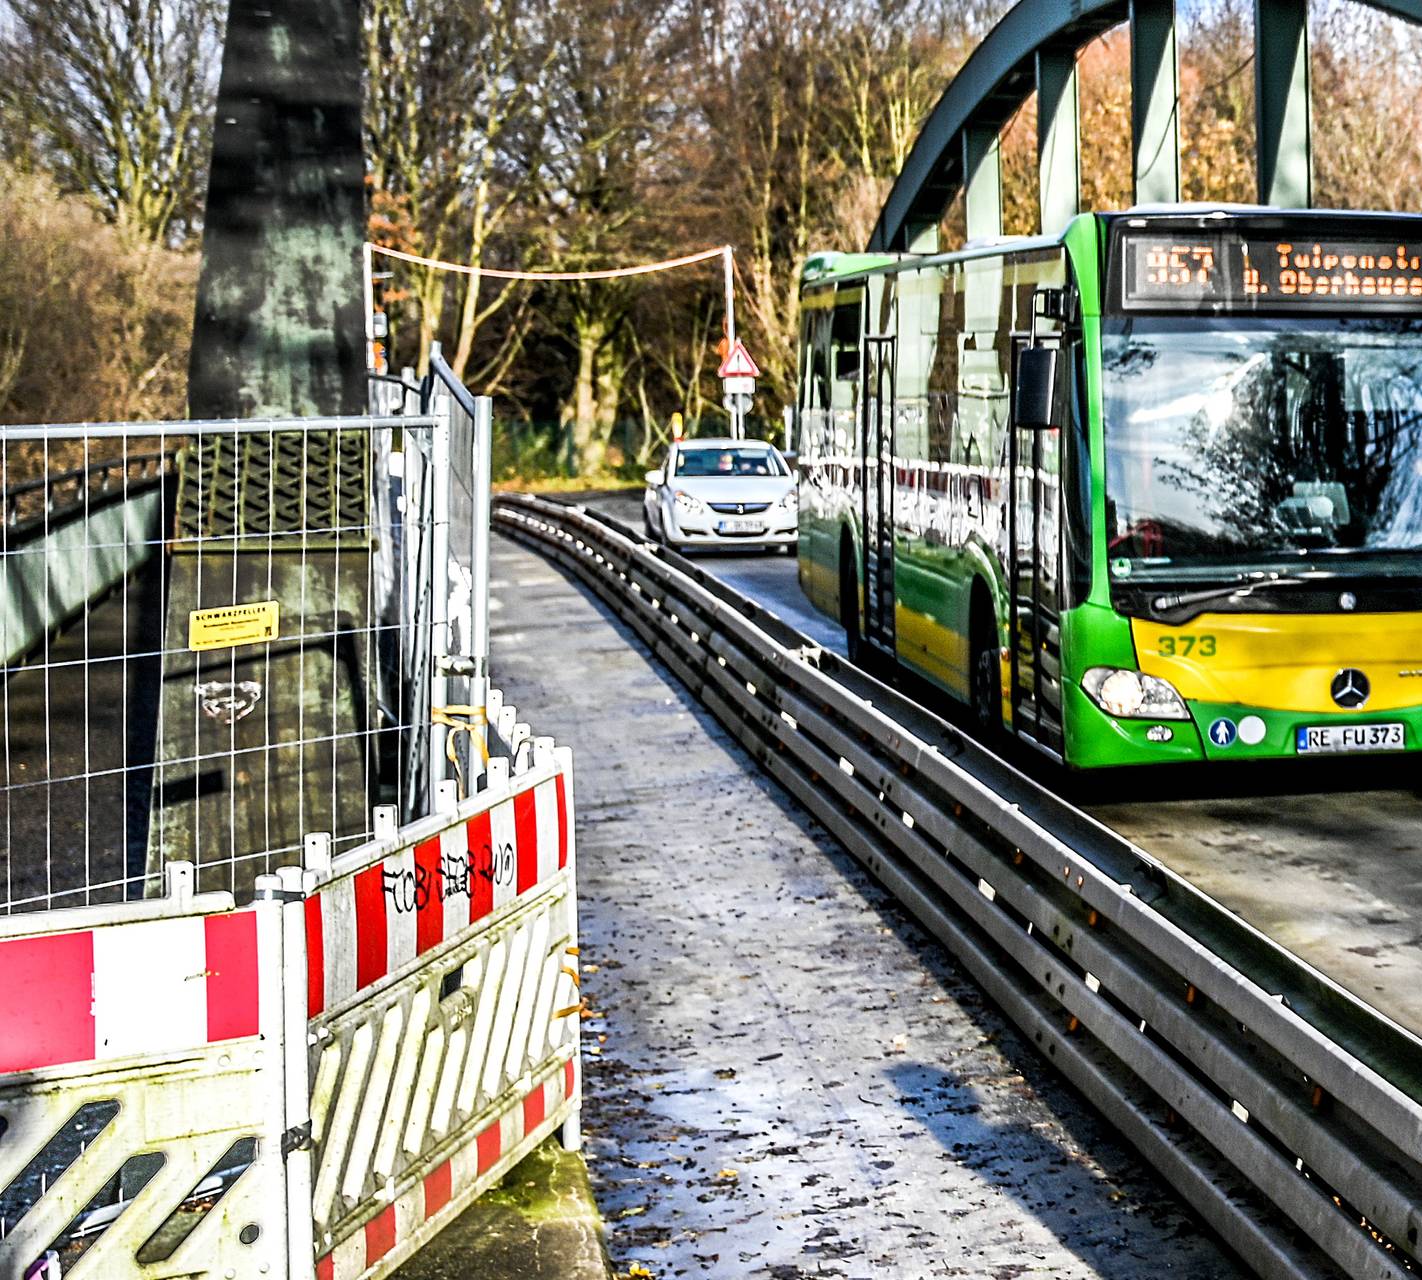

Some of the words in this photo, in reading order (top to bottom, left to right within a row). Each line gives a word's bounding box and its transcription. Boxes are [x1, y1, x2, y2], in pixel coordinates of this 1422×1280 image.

[1158, 635, 1217, 657] 373
[1309, 730, 1331, 746] RE
[1343, 728, 1366, 745] FU
[1370, 727, 1401, 744] 373
